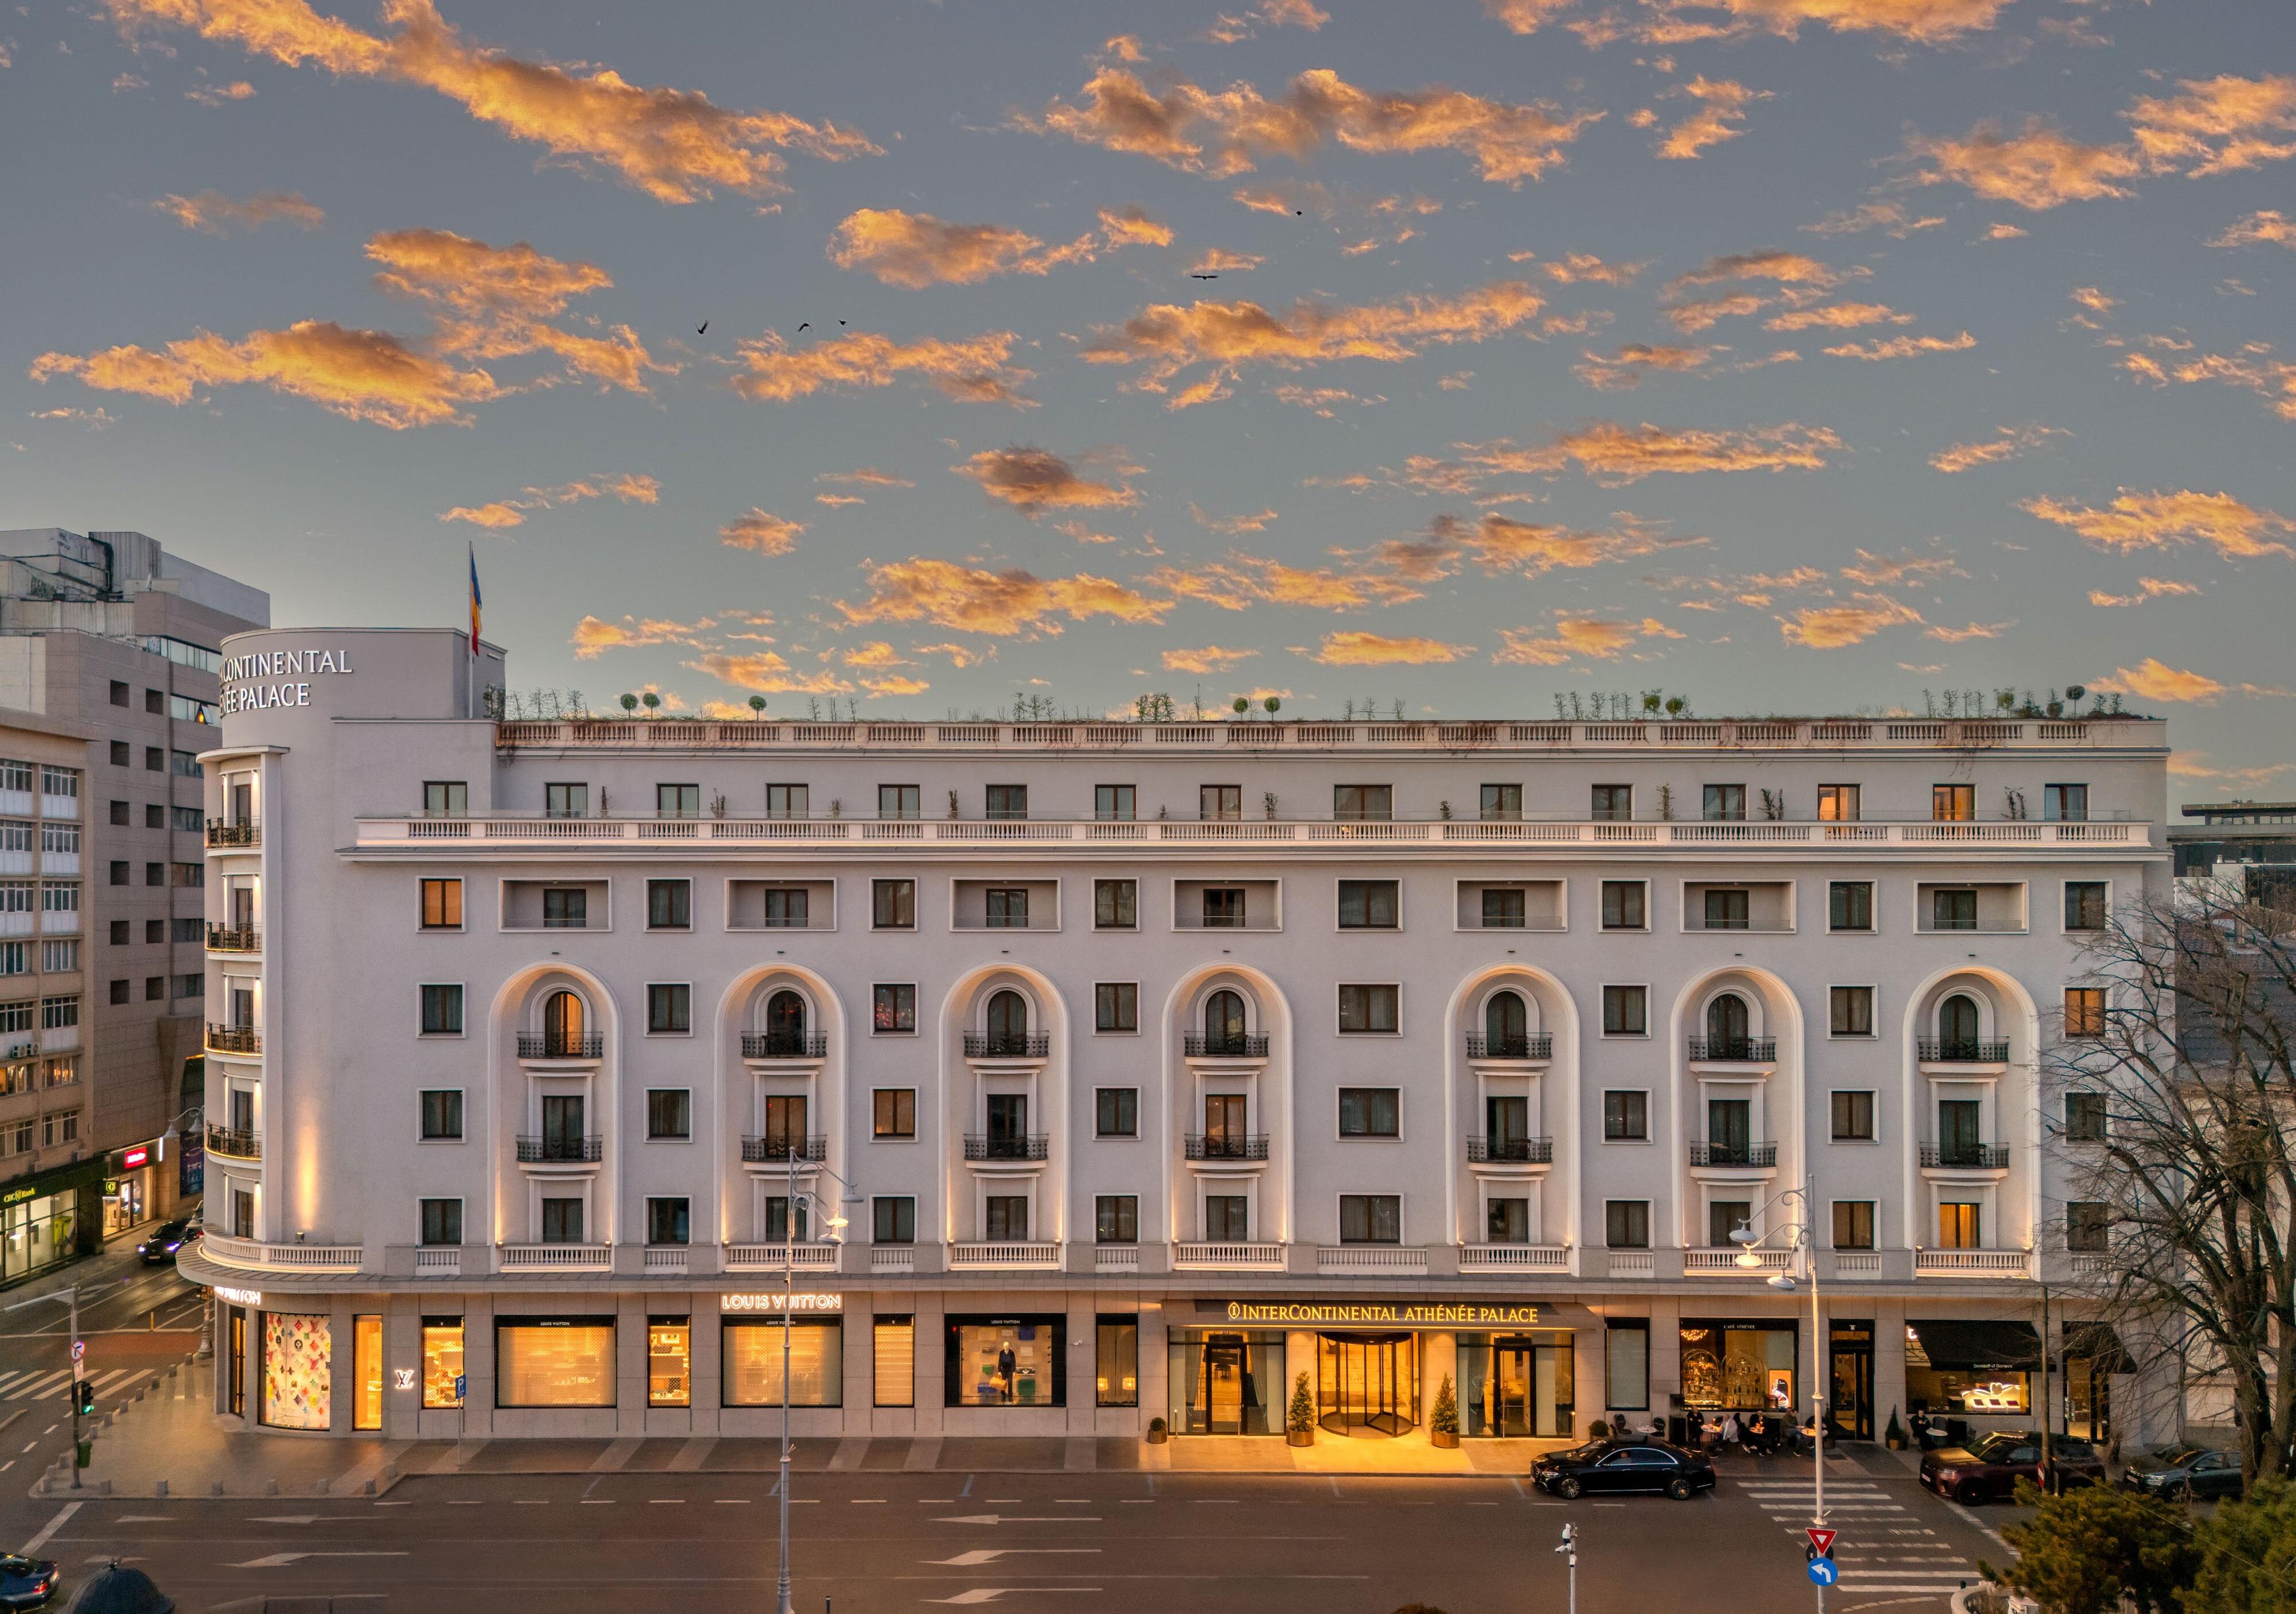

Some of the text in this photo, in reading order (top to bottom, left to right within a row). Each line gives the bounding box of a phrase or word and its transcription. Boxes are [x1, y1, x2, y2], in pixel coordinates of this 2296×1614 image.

[240, 683, 310, 710] PALACE
[22, 1187, 35, 1198] Bank
[722, 1295, 841, 1309] LOUIS VUITTON
[1243, 1304, 1399, 1321] INTERCONTINENTAL
[1405, 1304, 1475, 1322] ATHÉNÉE
[1480, 1308, 1537, 1322] PALACE
